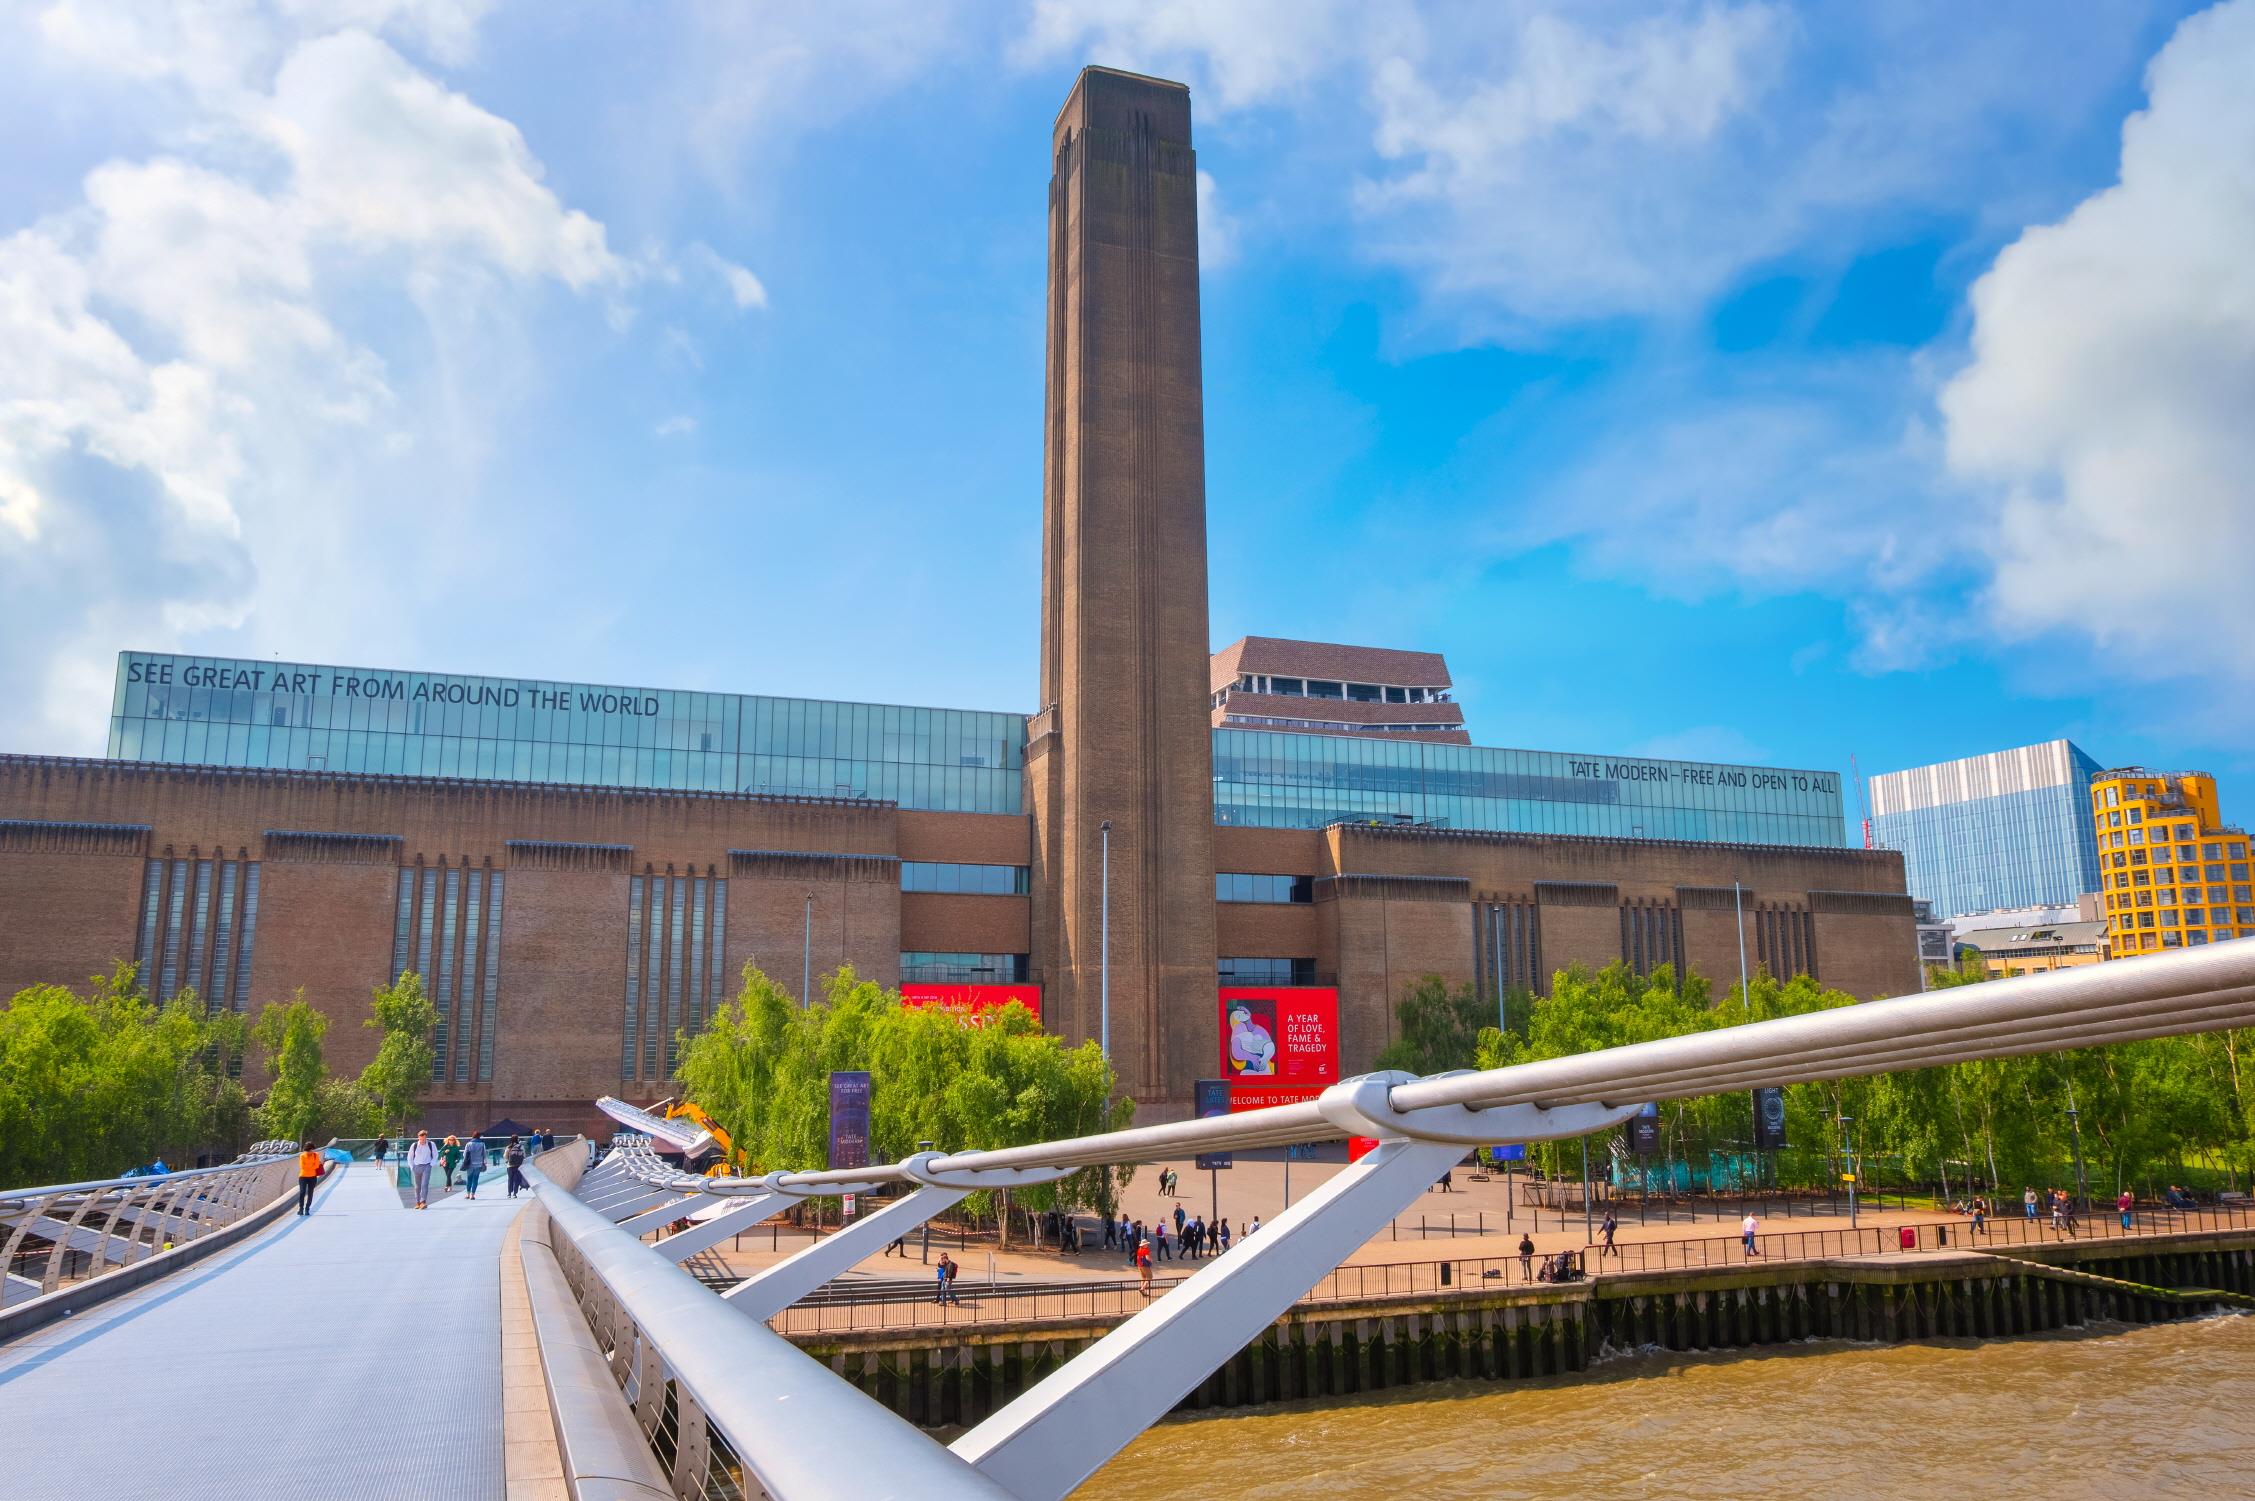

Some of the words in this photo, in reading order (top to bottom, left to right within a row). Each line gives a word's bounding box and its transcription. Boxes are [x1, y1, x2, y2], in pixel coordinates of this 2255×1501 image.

[127, 662, 173, 685] SEE
[183, 666, 265, 690] GREAT
[270, 672, 321, 694] ART
[331, 675, 404, 700] FROM
[412, 682, 519, 707] AROUND
[527, 689, 571, 711] THE
[579, 693, 659, 717] WORLD
[1569, 760, 1600, 779] TATE
[1605, 763, 1668, 782] MODERN
[1682, 768, 1713, 786] FREE
[1717, 771, 1747, 788] AND
[1752, 773, 1787, 790] OPEN
[1791, 776, 1808, 792] TO
[1812, 777, 1835, 794] ALL
[1287, 1014, 1293, 1022] A
[1296, 1014, 1318, 1022] YEAR
[1287, 1024, 1298, 1033] OF
[1302, 1024, 1325, 1034] LOVE,
[1288, 1034, 1311, 1042] FAME
[1314, 1034, 1320, 1042] &
[1288, 1044, 1327, 1052] TRAGEDY
[1268, 1096, 1277, 1104] TO
